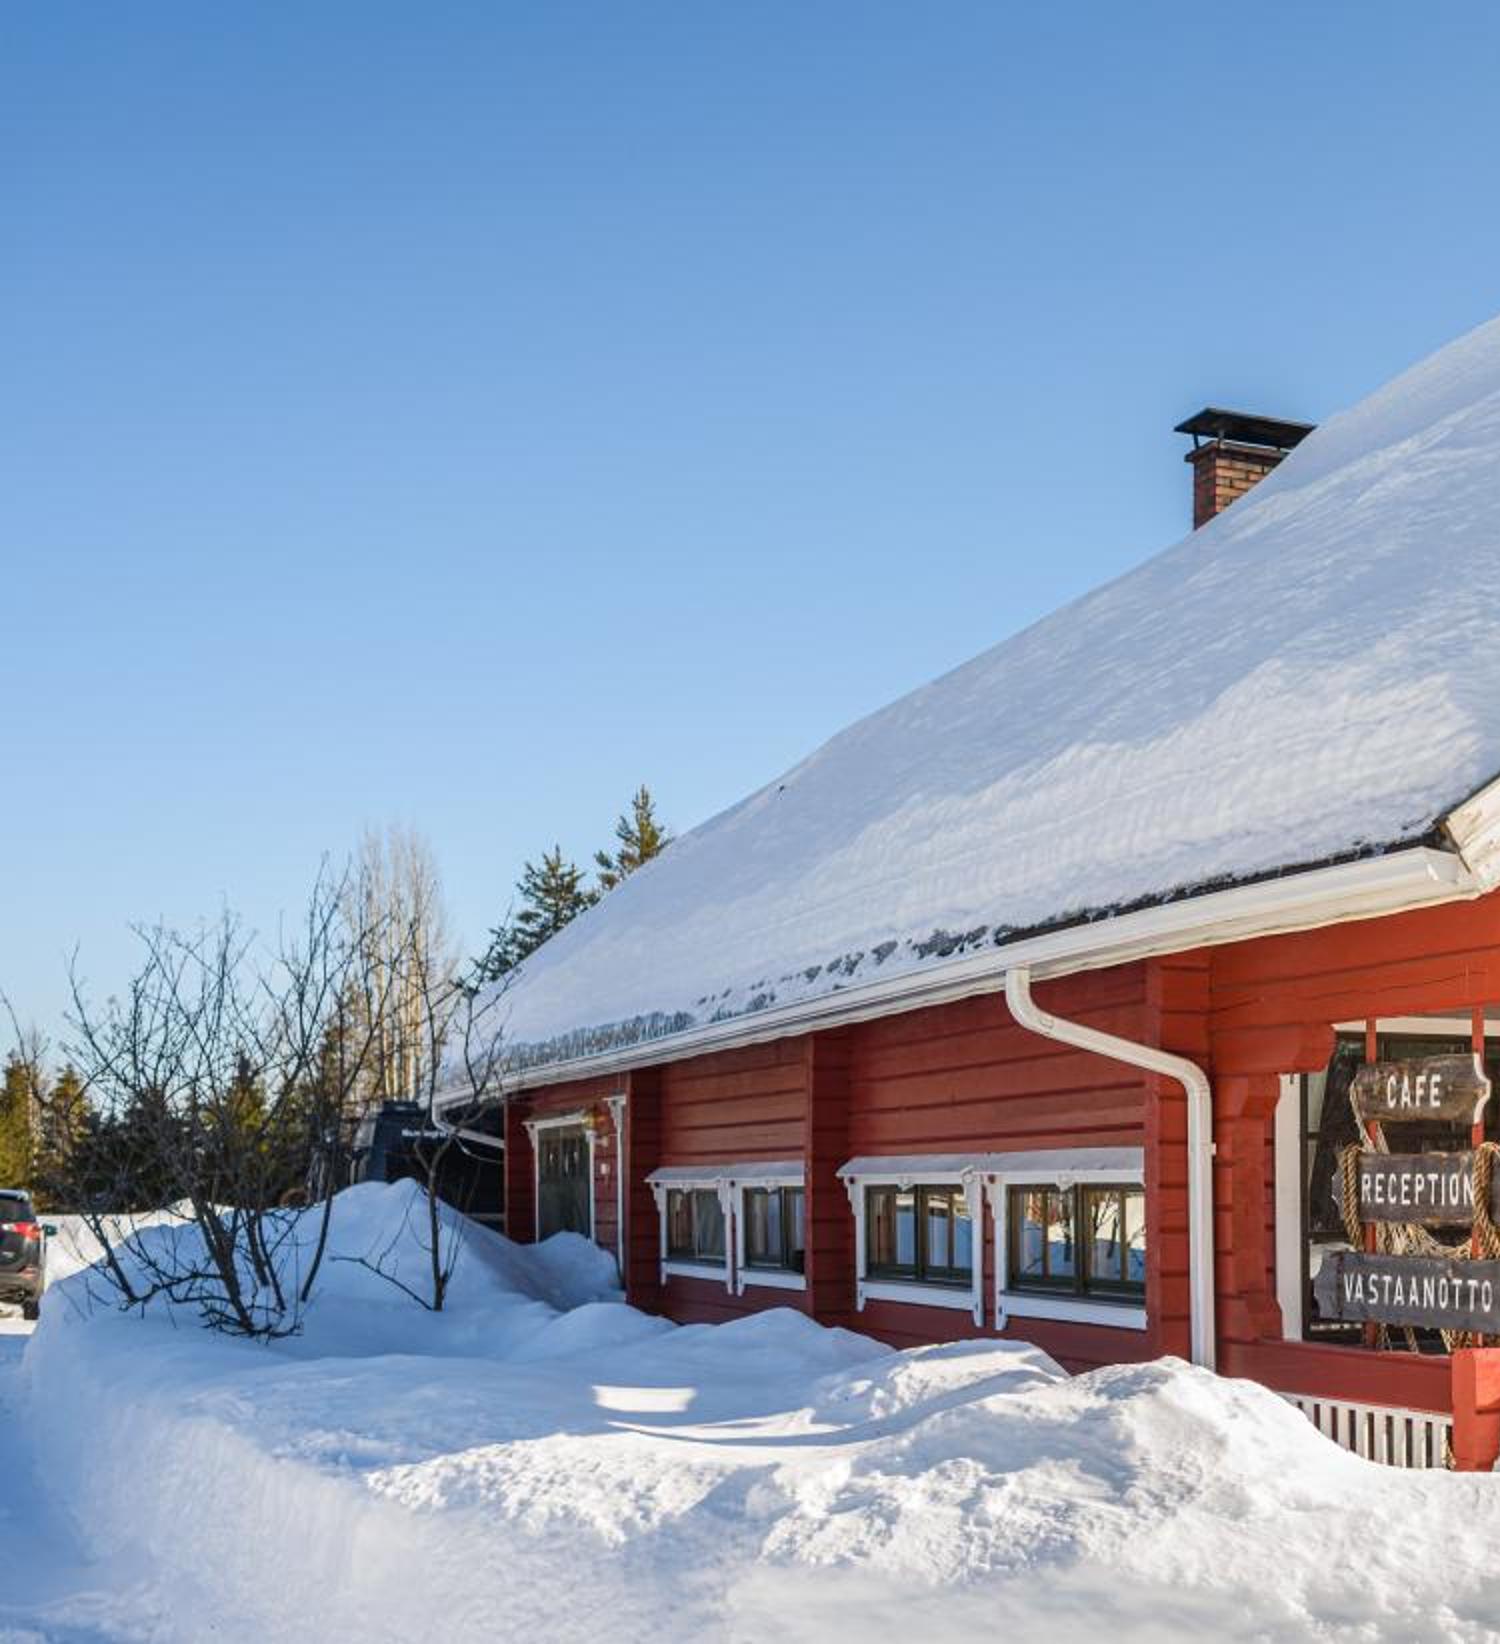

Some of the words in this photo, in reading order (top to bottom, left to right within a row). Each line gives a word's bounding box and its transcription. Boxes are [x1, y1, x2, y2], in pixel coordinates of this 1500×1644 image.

[1386, 1074, 1442, 1109] CAFE
[1361, 1173, 1475, 1206] RECEPTION
[1343, 1272, 1493, 1313] VASTAANOTTO
